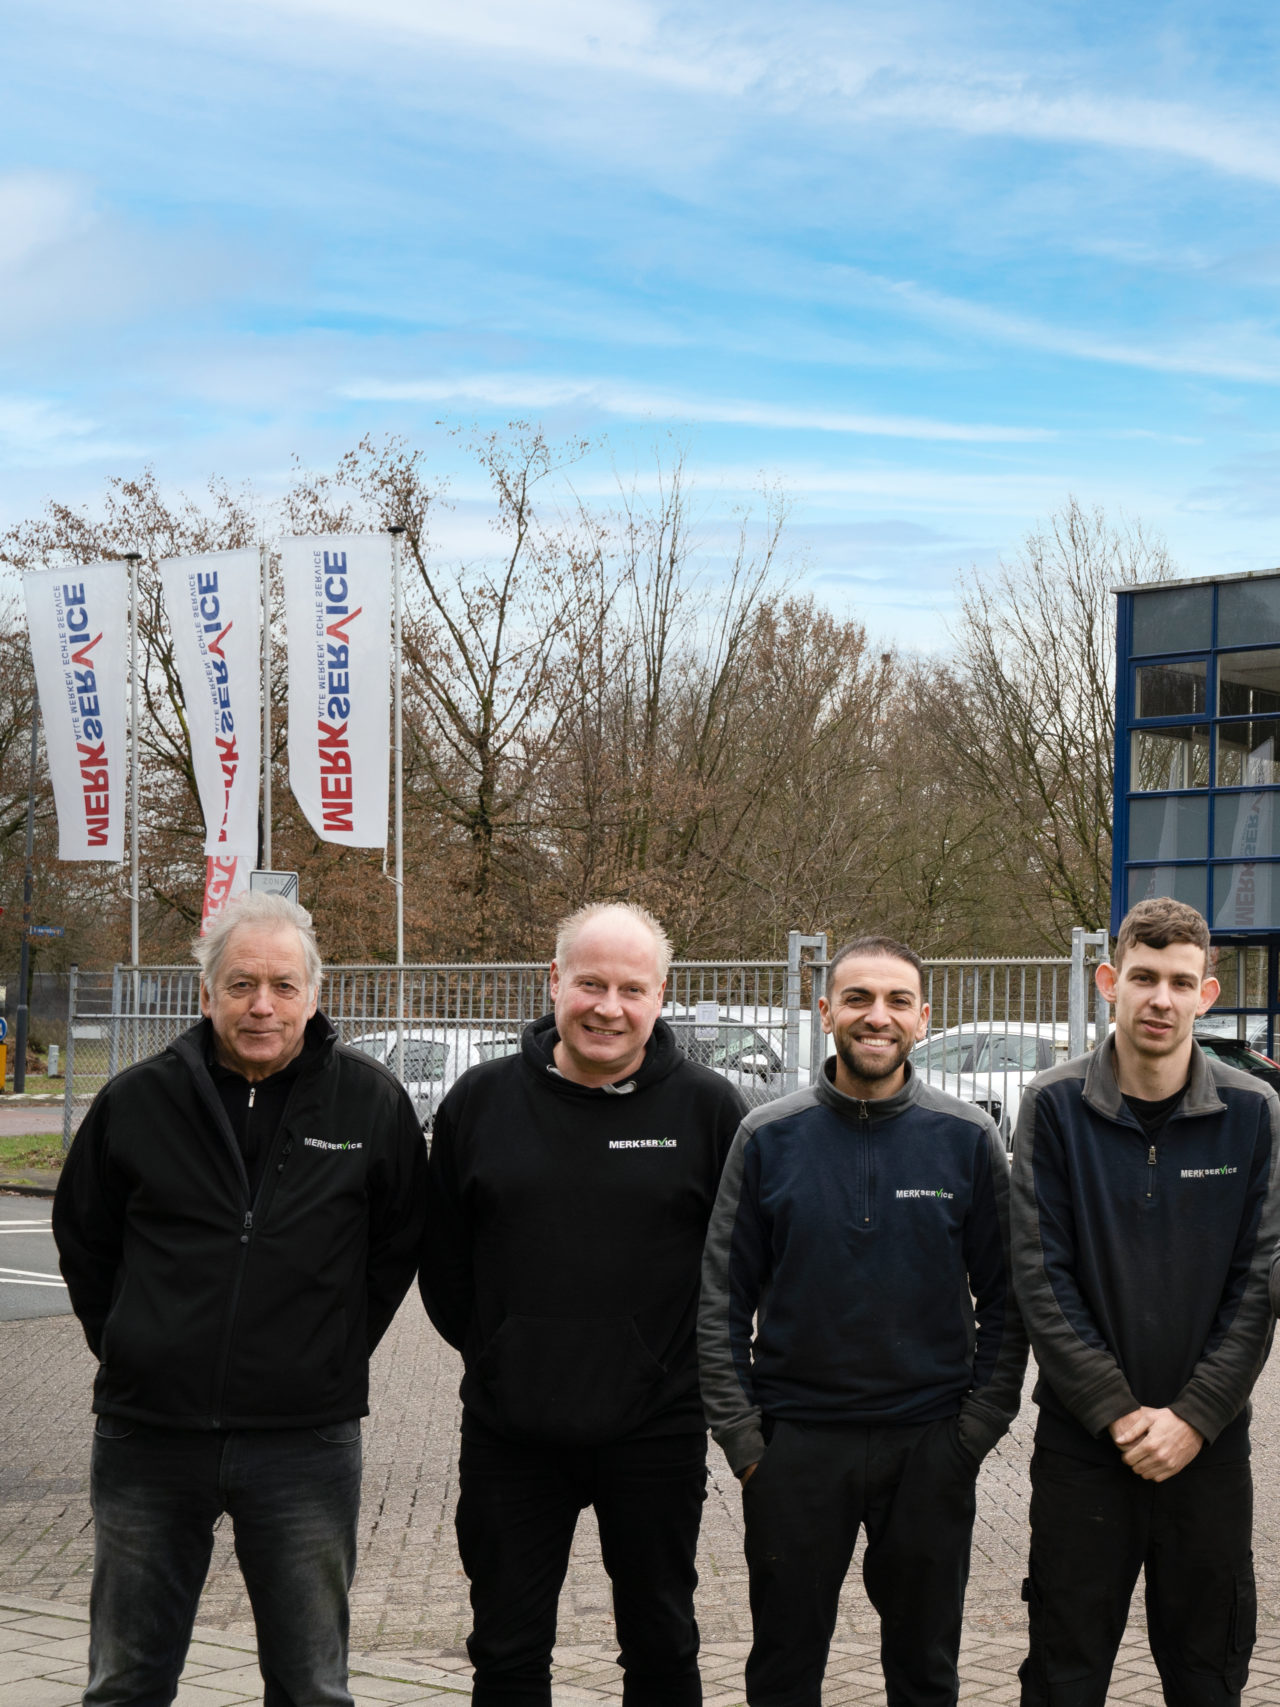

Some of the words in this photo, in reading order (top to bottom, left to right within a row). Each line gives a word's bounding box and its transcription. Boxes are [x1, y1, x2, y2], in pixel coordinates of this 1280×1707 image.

[263, 877, 286, 887] ZONE
[304, 1137, 363, 1150] MERKSERVICE
[609, 1137, 677, 1149] MERKSERVICE
[1180, 1164, 1238, 1178] MERKSERVICE
[896, 1188, 954, 1199] MERKSERVICE
